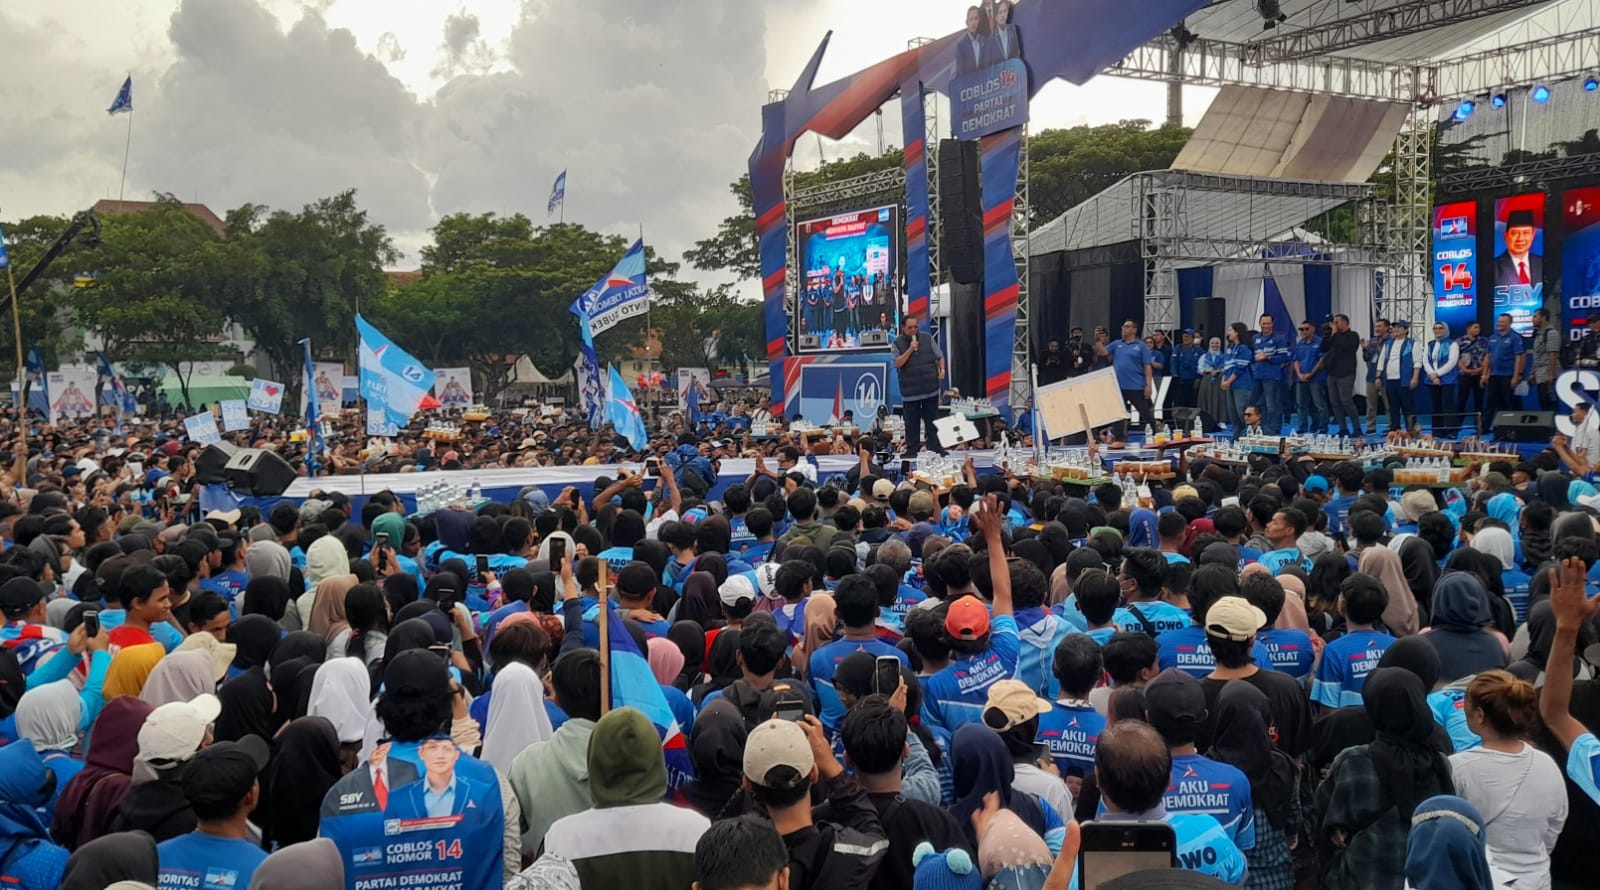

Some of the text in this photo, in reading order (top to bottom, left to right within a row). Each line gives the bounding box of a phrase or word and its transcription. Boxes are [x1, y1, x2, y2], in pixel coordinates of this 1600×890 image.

[960, 69, 1017, 102] COBLOS 14
[973, 96, 1004, 114] PARTAI
[962, 105, 1016, 133] DEMOKRAT
[1437, 248, 1472, 260] COBLOS
[1440, 262, 1472, 291] 14
[1494, 282, 1543, 307] SBY
[858, 381, 877, 409] 14
[958, 661, 1004, 689] DEMOKRAT
[969, 659, 988, 675] AKU
[1061, 729, 1087, 743] AKU
[1179, 780, 1209, 794] AKU
[340, 792, 364, 805] SBY
[386, 838, 464, 861] COBLOS 14
[386, 851, 433, 865] NOMOR
[354, 871, 464, 890] PARTAI DEMOKRAT
